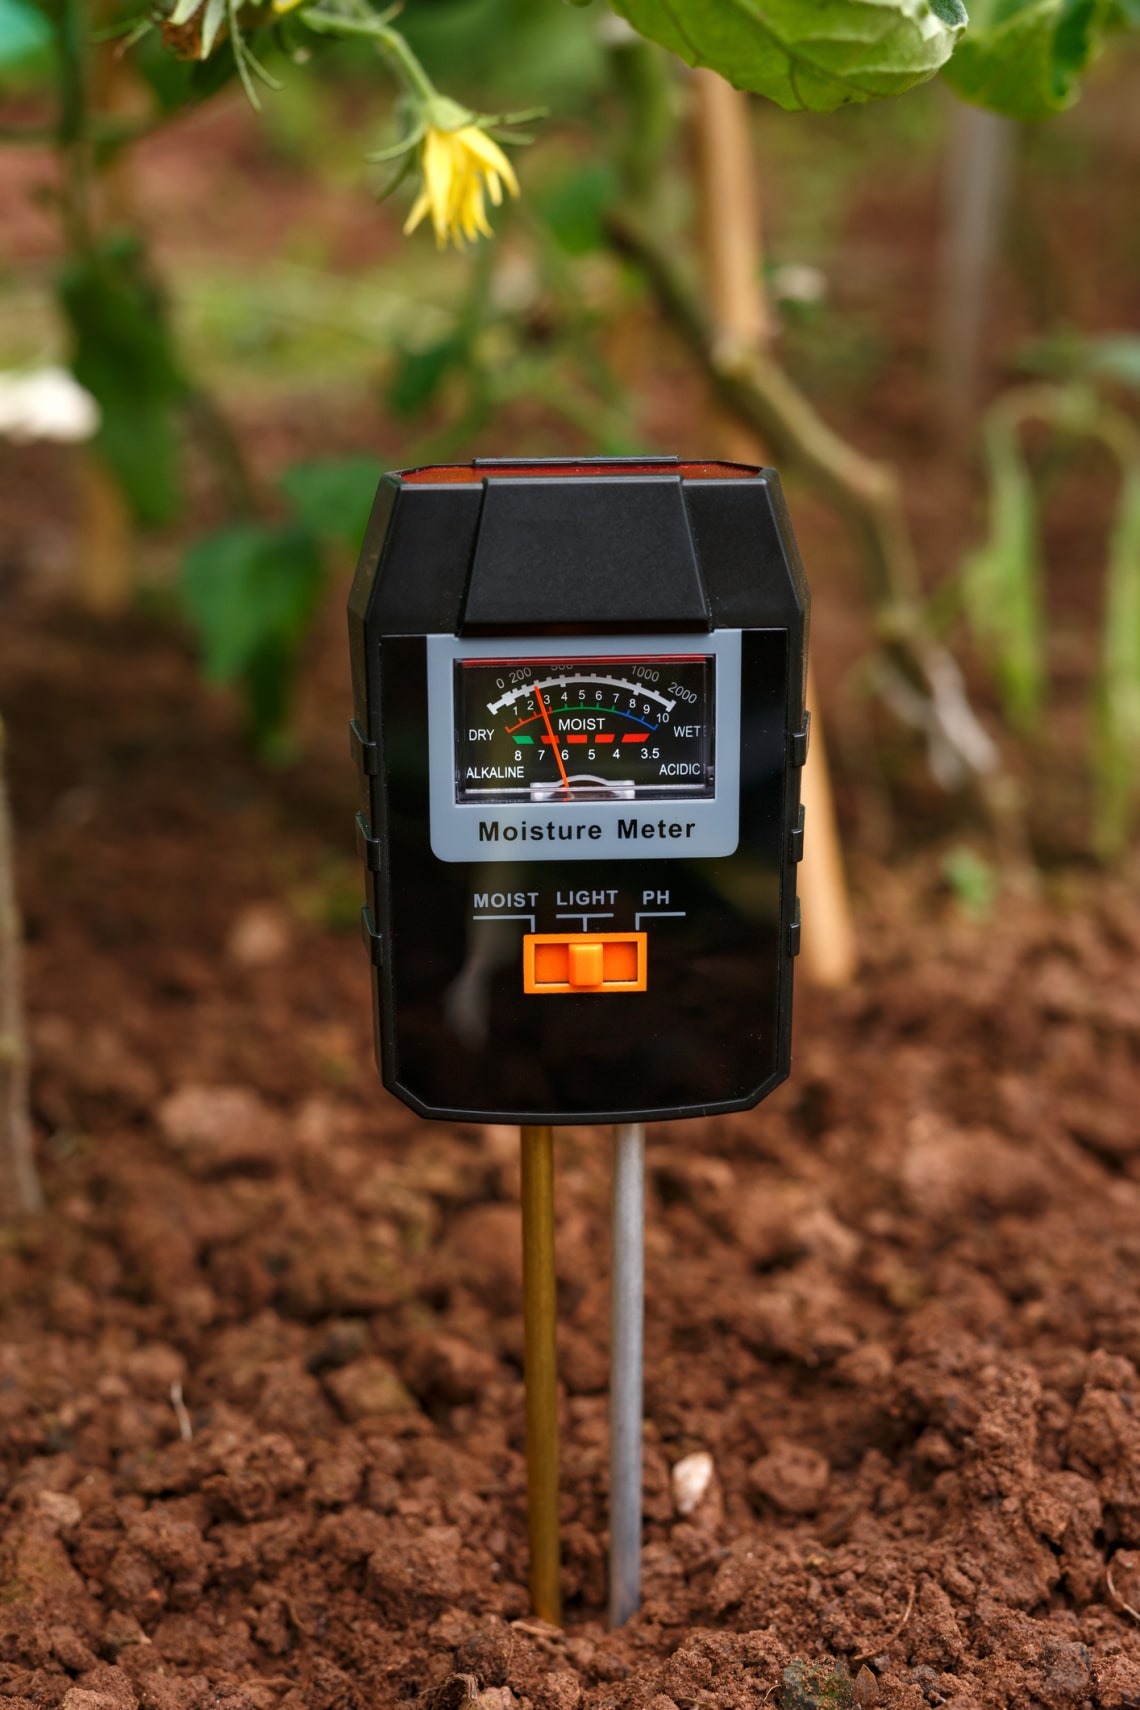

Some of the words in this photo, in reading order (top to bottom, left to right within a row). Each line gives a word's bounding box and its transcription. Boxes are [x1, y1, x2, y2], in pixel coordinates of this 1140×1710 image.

[496, 678, 505, 689] 0
[508, 667, 532, 684] 200
[631, 665, 660, 682] 1000
[667, 682, 698, 704] 2000
[513, 706, 518, 716] 1
[527, 700, 535, 711] 2
[543, 694, 551, 705] 3
[561, 691, 568, 702] 4
[578, 689, 586, 700] 5
[595, 690, 603, 701] 6
[613, 693, 620, 703] 7
[629, 698, 636, 708] 8
[643, 704, 651, 714] 9
[656, 712, 670, 723] 10
[558, 718, 606, 731] MOIST
[673, 725, 701, 738] WET
[468, 729, 495, 741] DRY
[514, 750, 522, 761] 8
[538, 750, 545, 761] 7
[561, 749, 569, 760] 6
[588, 749, 596, 760] 5
[612, 748, 620, 759] 4
[640, 747, 660, 759] 3.5
[466, 766, 525, 779] ALKALINE
[659, 763, 701, 776] ACIDIC
[479, 821, 602, 842] Moisture
[617, 819, 696, 839] Meter
[473, 892, 539, 908] MOIST
[556, 890, 619, 906] LIGHT
[642, 890, 670, 905] PH
